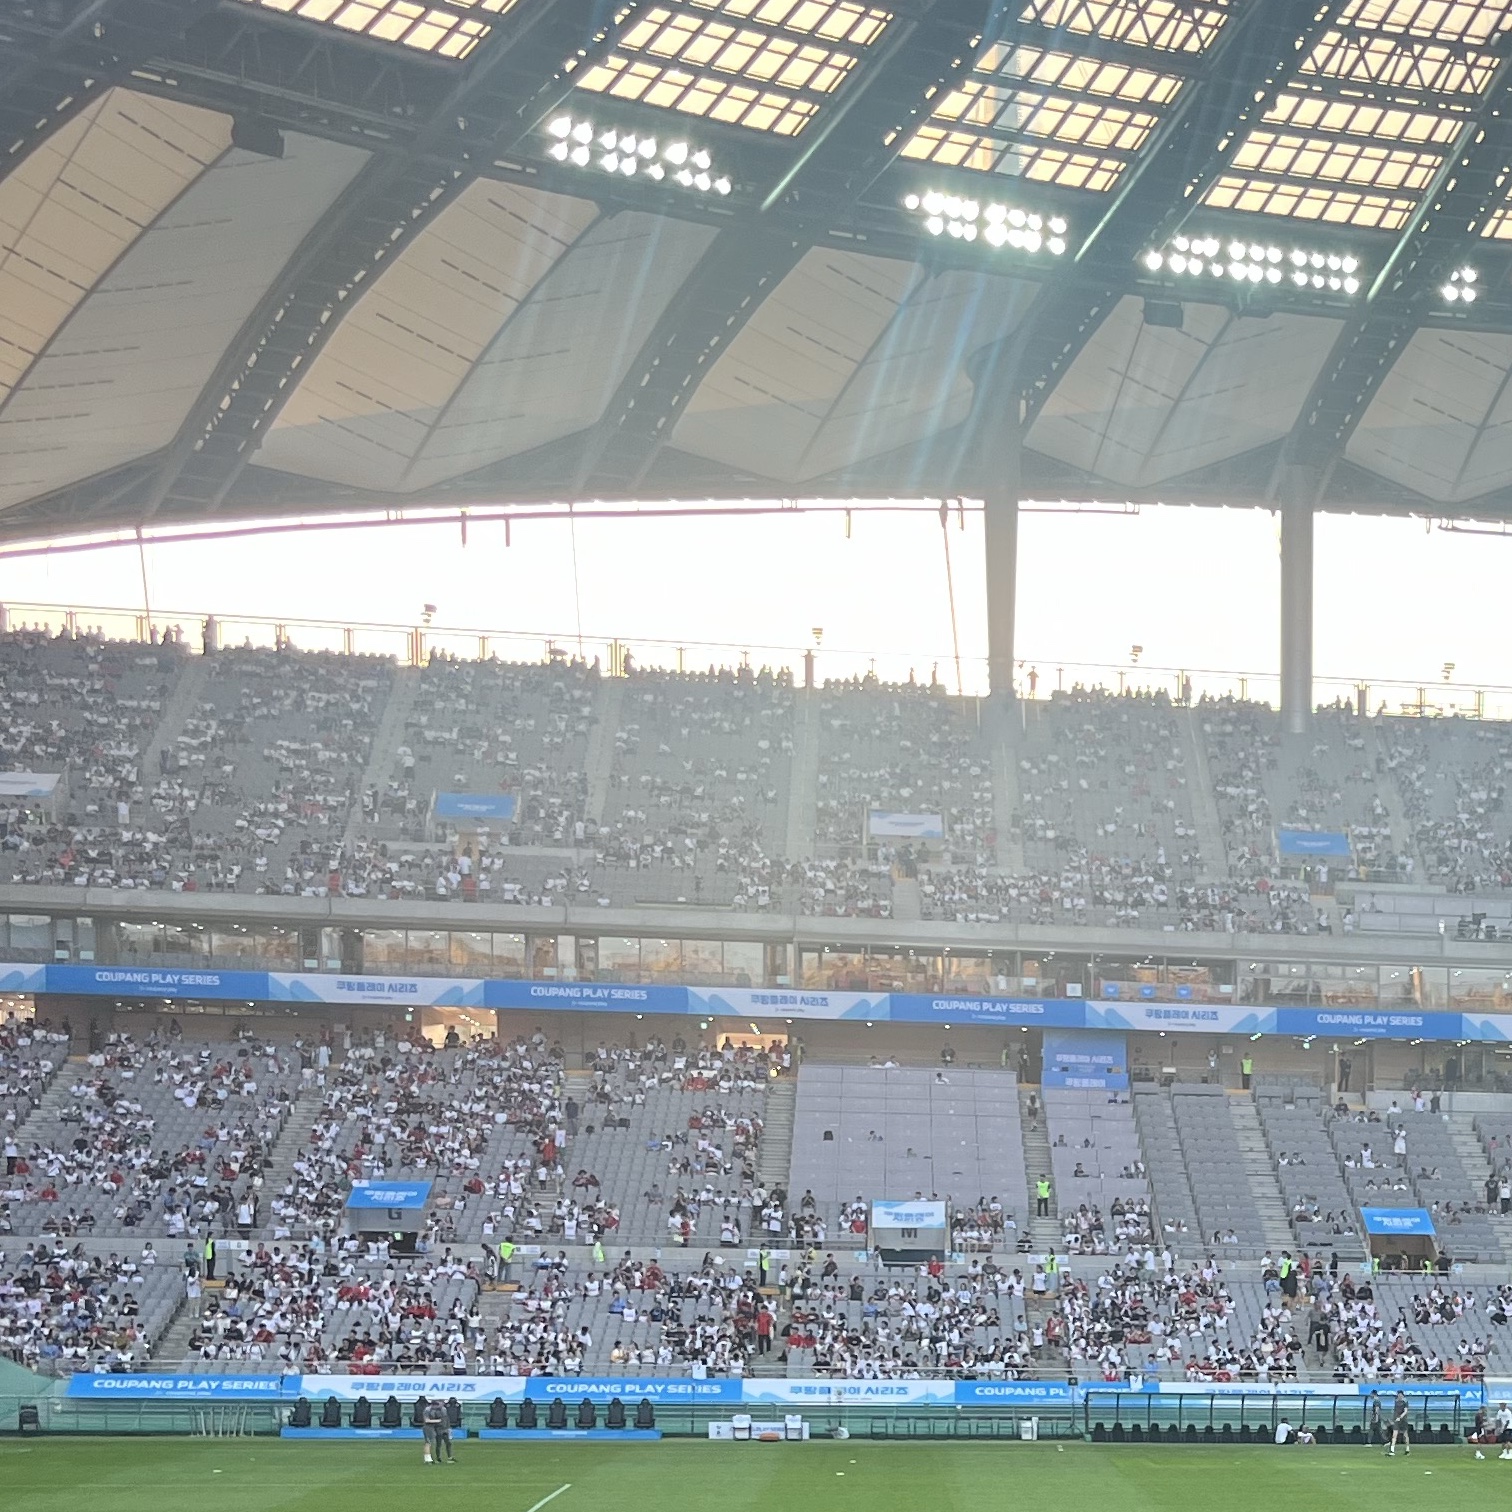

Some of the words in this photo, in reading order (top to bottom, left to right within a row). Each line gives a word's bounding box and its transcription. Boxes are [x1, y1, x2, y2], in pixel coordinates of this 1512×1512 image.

[96, 972, 150, 983] COUPANG
[152, 973, 180, 984] PLAY
[182, 975, 220, 986] SERIES
[336, 980, 385, 992] 쿠팡플레이
[388, 982, 418, 993] 시리즈
[531, 986, 581, 998] COUPANG
[583, 988, 610, 998] PLAY
[611, 990, 648, 1000] SERIES
[800, 996, 829, 1007] 시리즈
[932, 1000, 981, 1011] COUPANG
[982, 1002, 1009, 1012] PLAY
[1010, 1003, 1044, 1014] SERIES
[1191, 1010, 1218, 1020] 시리즈
[1316, 1014, 1363, 1024] COUPANG
[1364, 1016, 1389, 1025] PLAY
[1390, 1016, 1423, 1026] SERIES
[388, 1208, 402, 1220] G
[92, 1379, 174, 1390] COUPANG
[176, 1380, 216, 1390] PLAY
[221, 1380, 278, 1390] SERIES
[350, 1382, 426, 1392] 쿠팡플레이
[429, 1382, 476, 1392] 시리즈
[546, 1384, 622, 1394] COUPANG
[624, 1384, 664, 1394] PLAY
[666, 1384, 722, 1394] SERIES
[864, 1386, 909, 1396] 시리즈
[974, 1388, 1046, 1396] COUPANG
[1048, 1388, 1088, 1396] PLY
